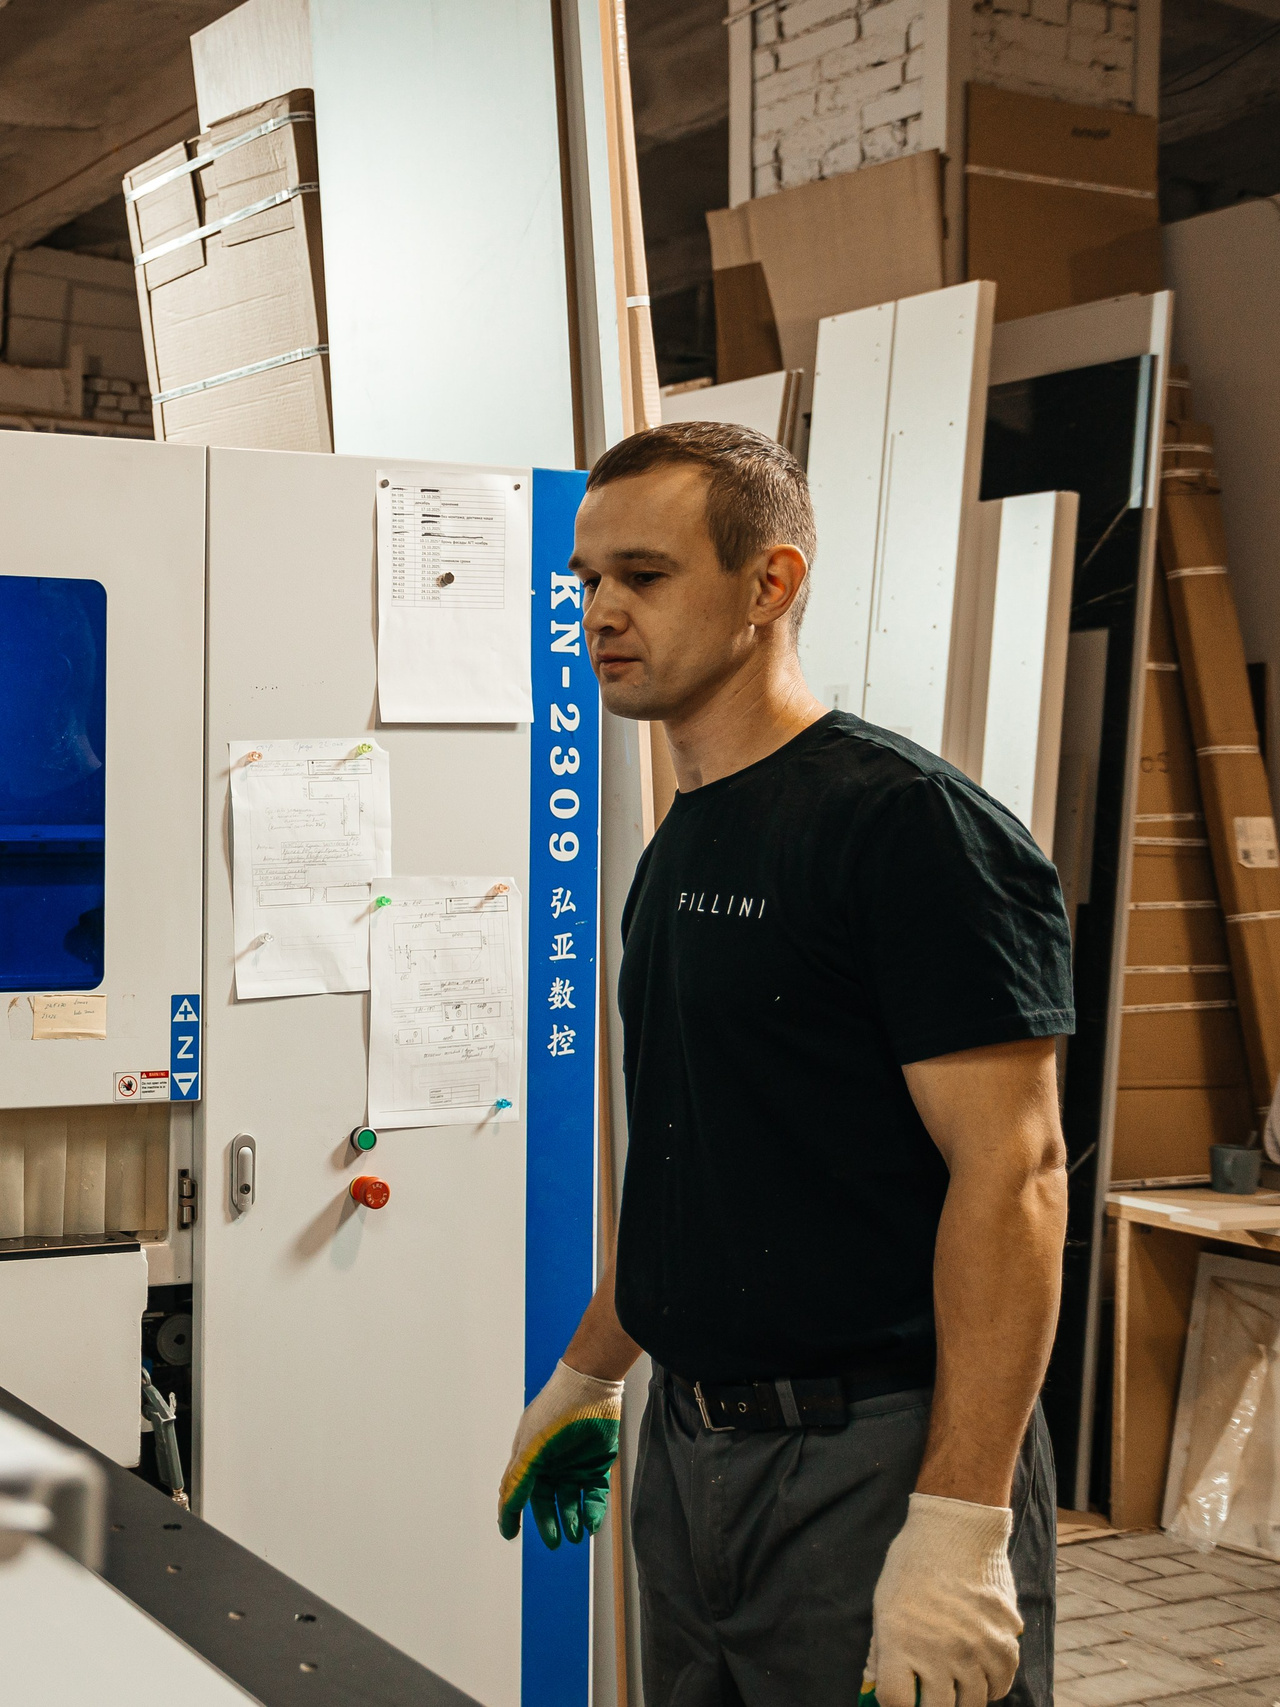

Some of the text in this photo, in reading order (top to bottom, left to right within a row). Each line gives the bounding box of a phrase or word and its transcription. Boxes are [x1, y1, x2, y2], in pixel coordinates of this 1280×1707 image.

[548, 571, 581, 863] KN-2309
[678, 892, 766, 919] FILLINI
[547, 887, 577, 1058] 弘亚数控
[177, 1036, 194, 1059] Z
